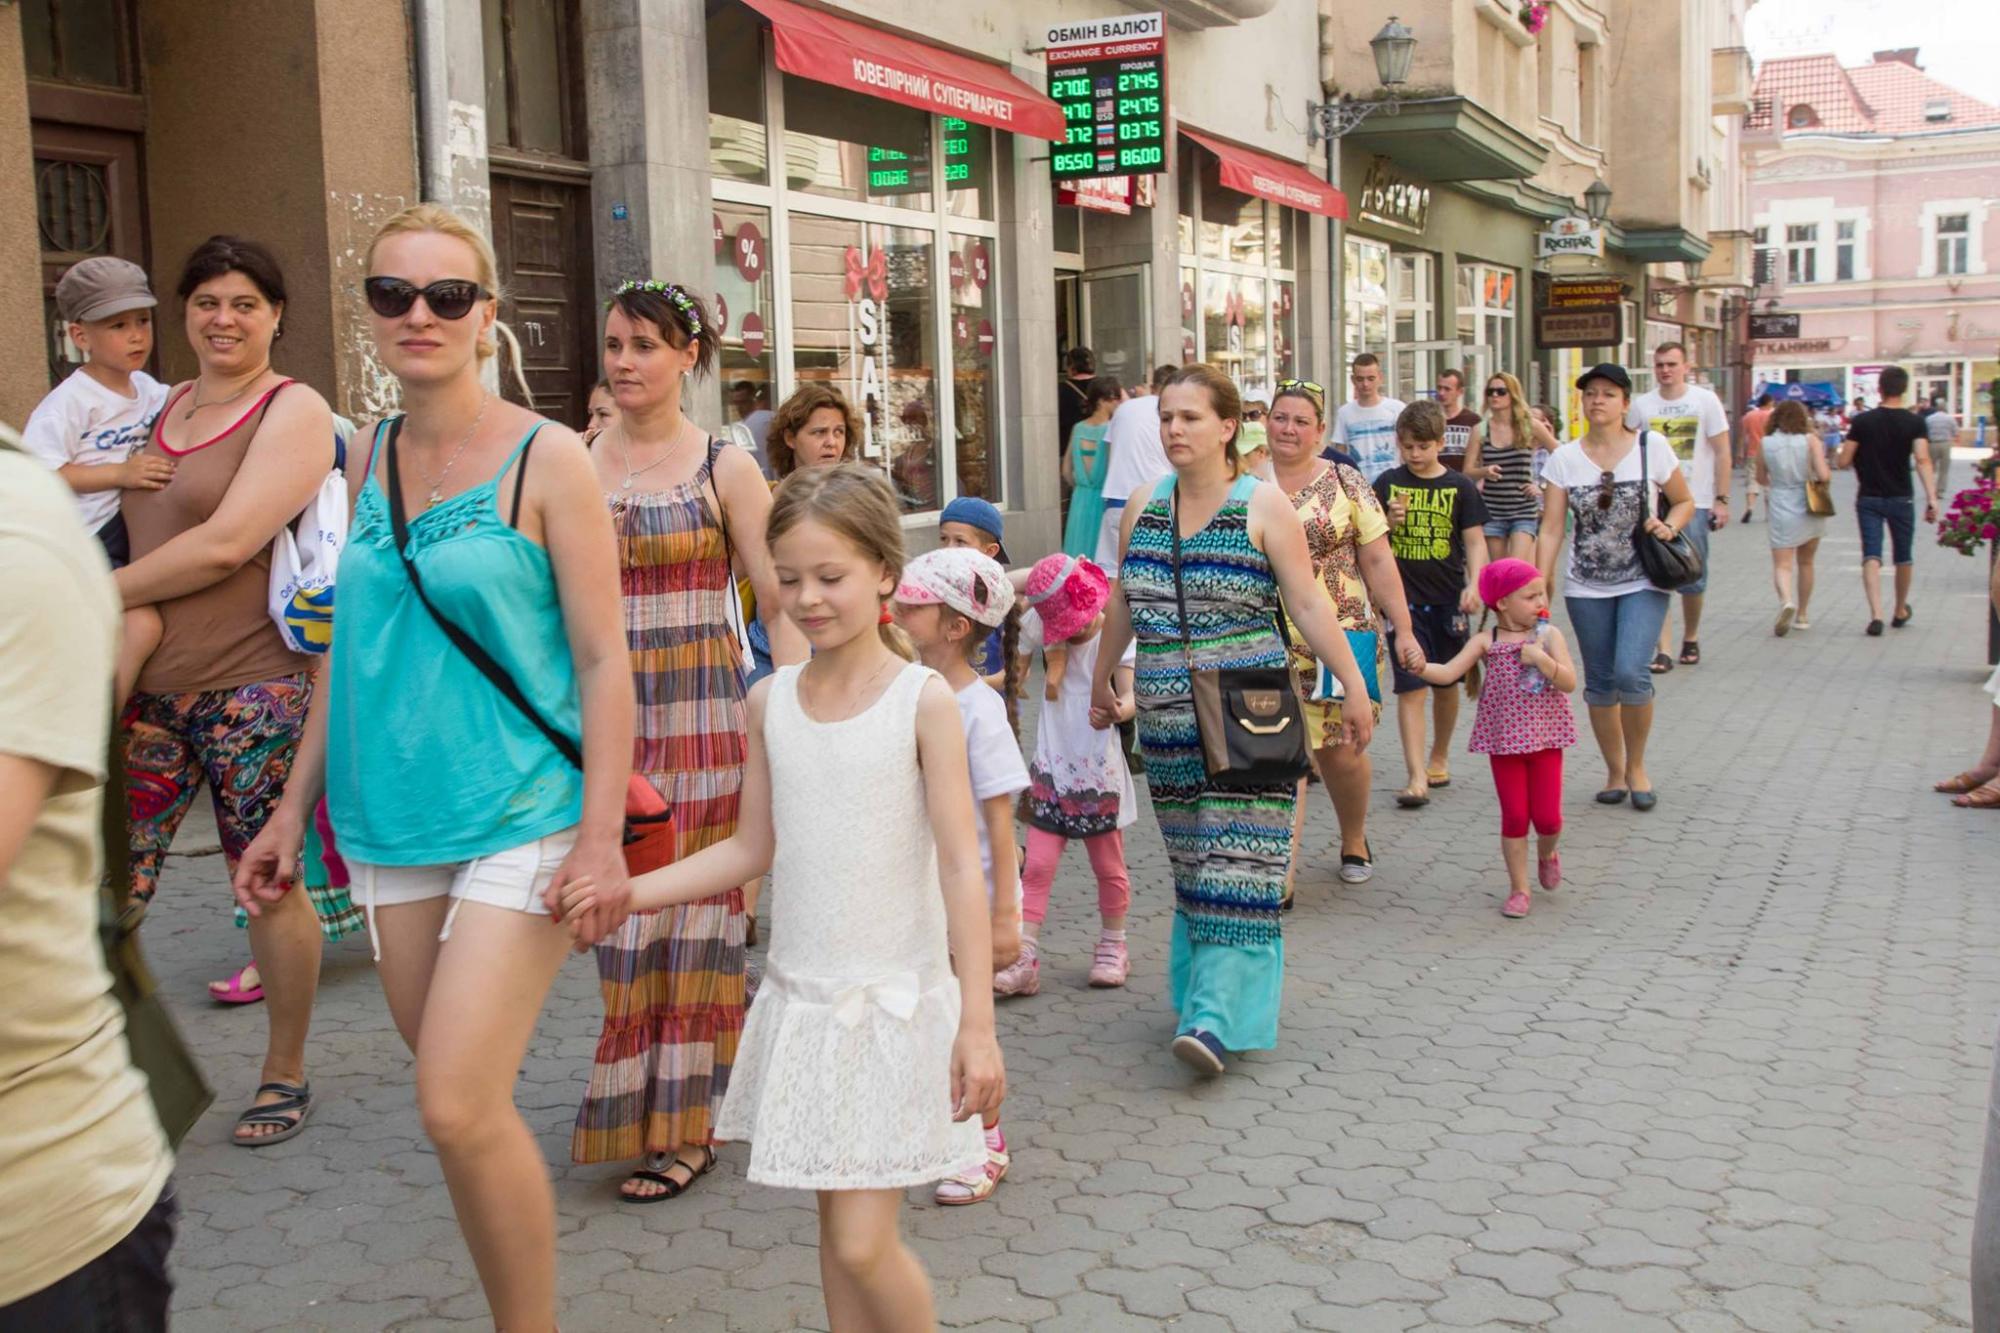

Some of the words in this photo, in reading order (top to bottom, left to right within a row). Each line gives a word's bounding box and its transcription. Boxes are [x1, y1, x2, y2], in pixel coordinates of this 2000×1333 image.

[1048, 26, 1097, 43] ОБМІН
[1102, 19, 1158, 37] ВАЛЮТ
[1049, 47, 1101, 61] EXCHANGE
[1105, 41, 1159, 55] CURRENCY
[1120, 61, 1156, 71] ПРОДАЖ
[853, 57, 931, 100] ЮВЕЛІРНИЙ
[933, 81, 1013, 121] СУПЕРМАРКЕТ
[1096, 88, 1113, 98] EUR
[1062, 102, 1092, 120] 470
[1096, 113, 1114, 122] USD
[1097, 163, 1116, 172] HUF
[1759, 340, 1830, 353] ТКАНИНИ
[1408, 526, 1431, 538] YORK
